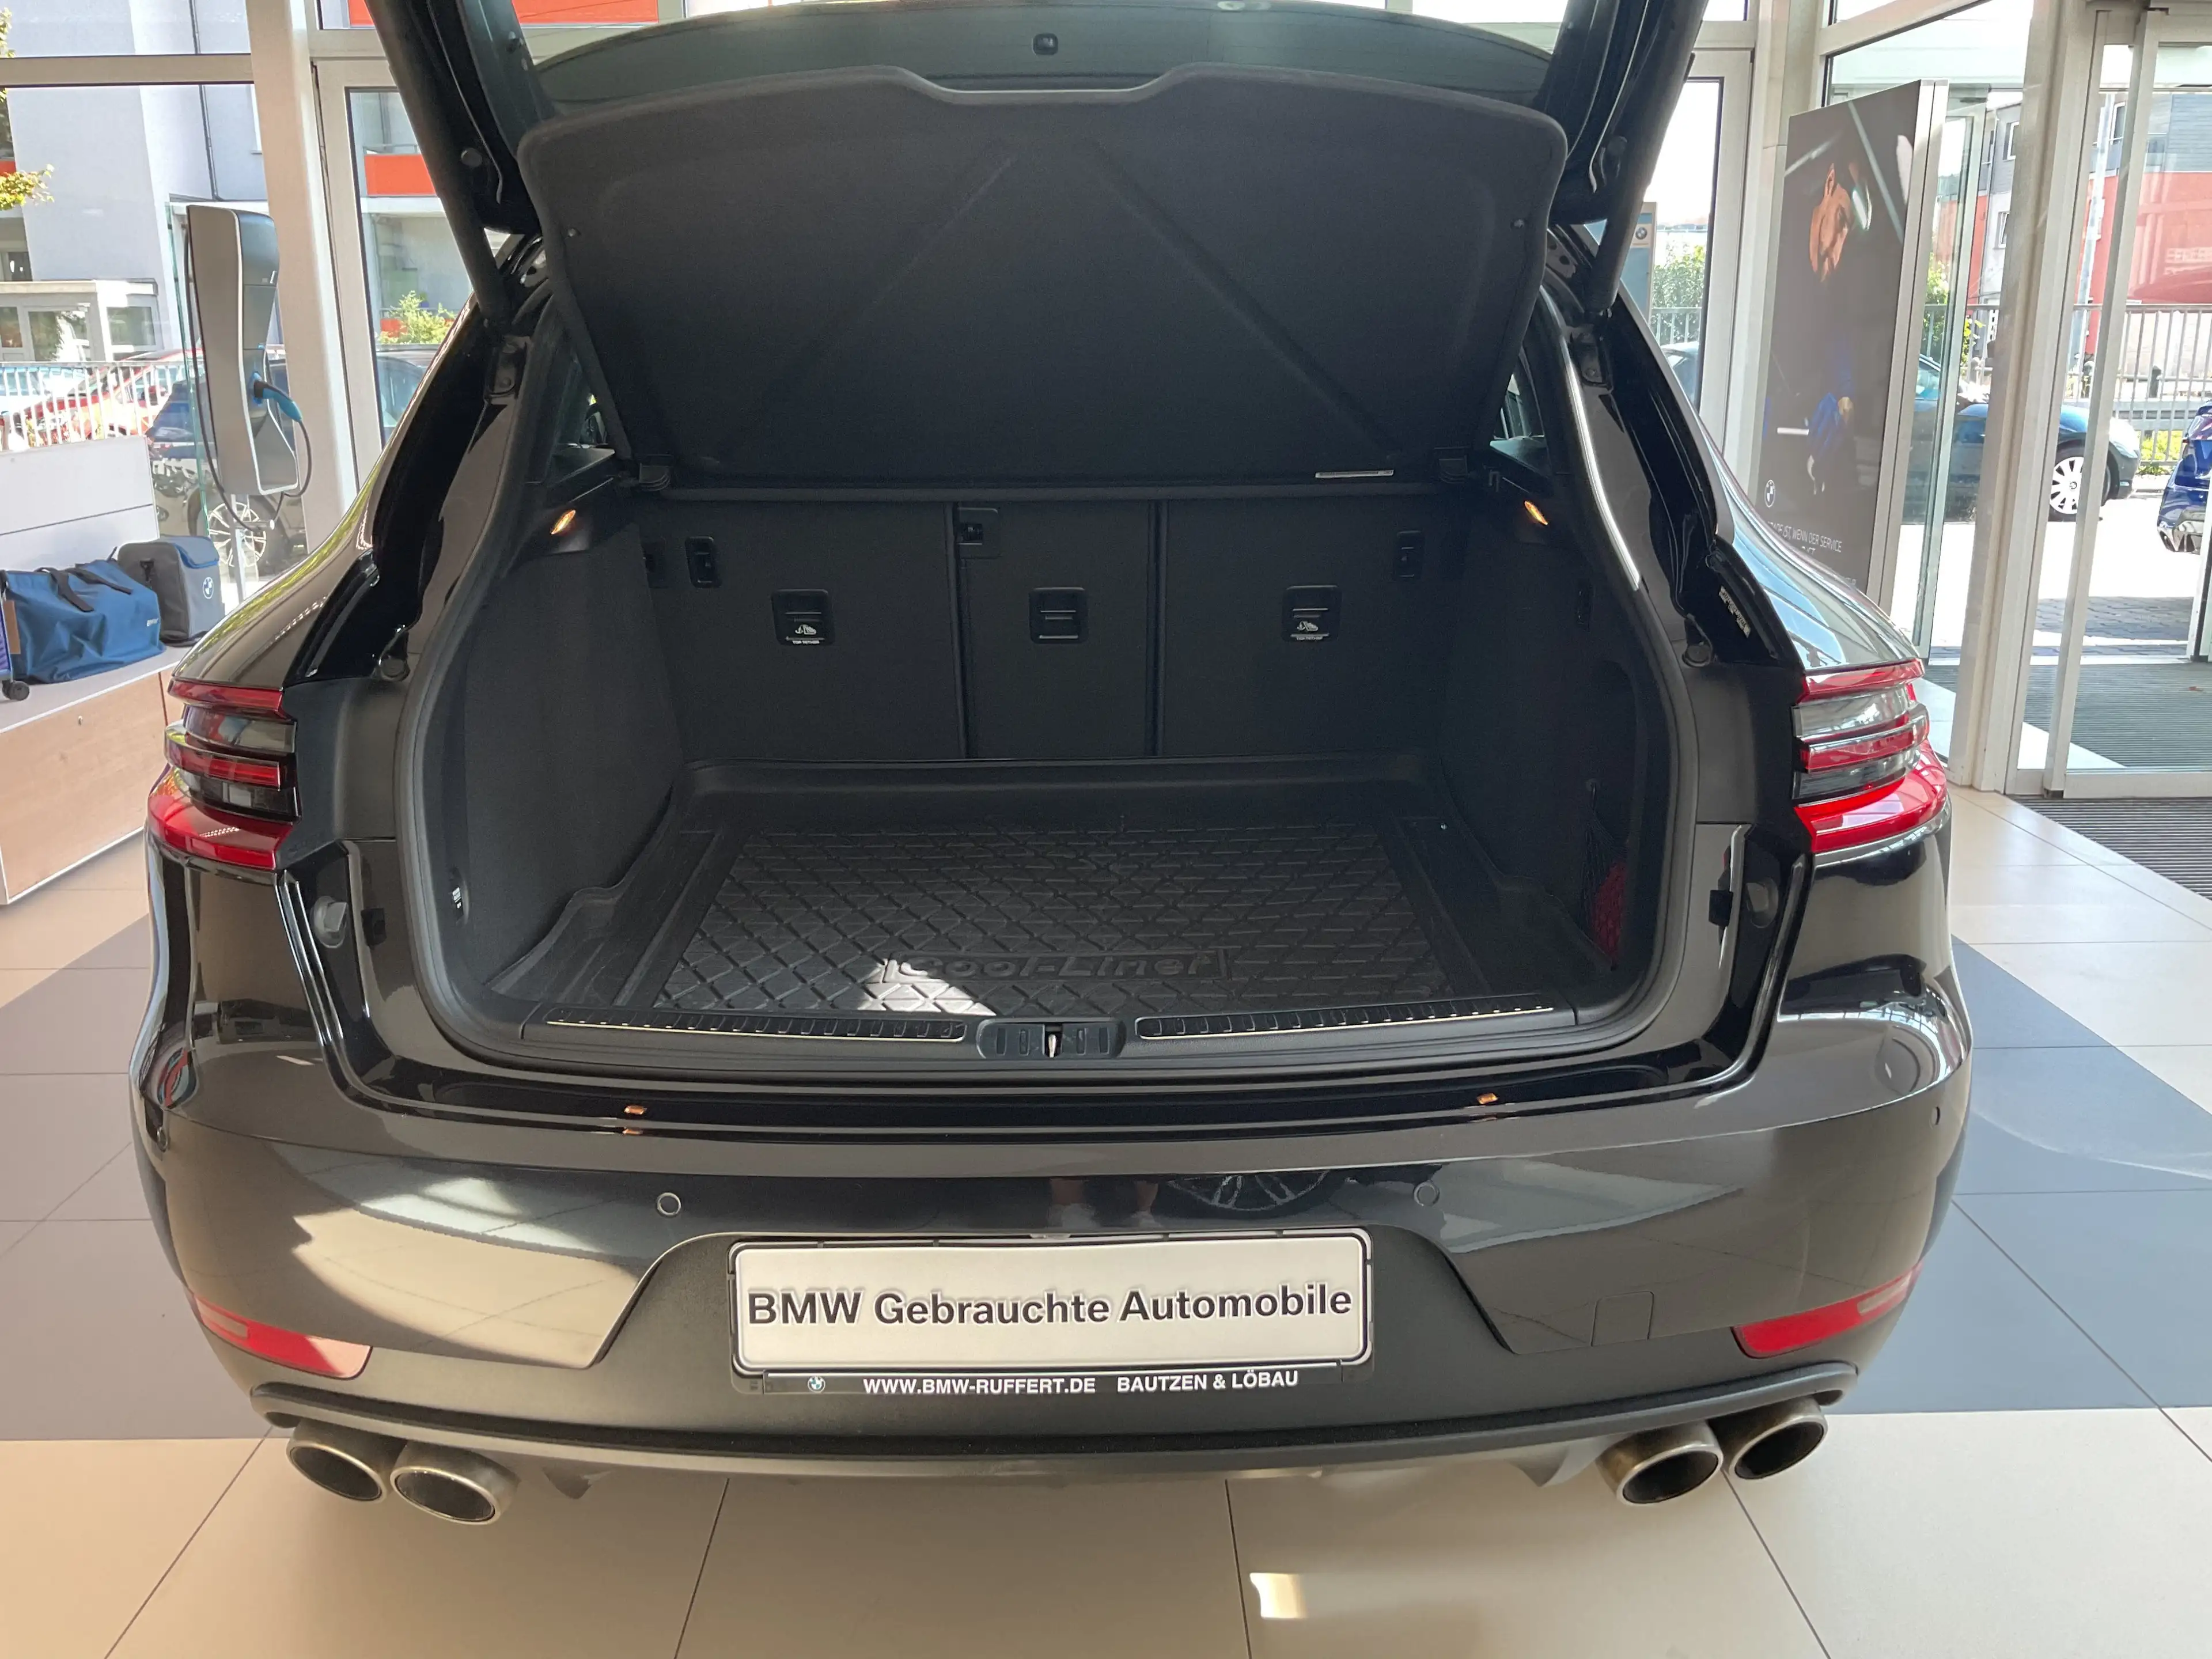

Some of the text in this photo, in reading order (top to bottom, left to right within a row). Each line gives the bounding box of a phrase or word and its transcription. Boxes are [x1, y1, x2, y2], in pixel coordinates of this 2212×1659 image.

[1792, 528, 1808, 542] WENN
[1809, 532, 1819, 545] DER
[1820, 536, 1842, 552] SERVICE
[899, 956, 1210, 977] Cool-Liner
[748, 1283, 1353, 1324] BMW Gebrauchte Automobile
[863, 1369, 1299, 1395] WWW.BMW-RUFFERT.DE BAUTZEN & LÖBAU
